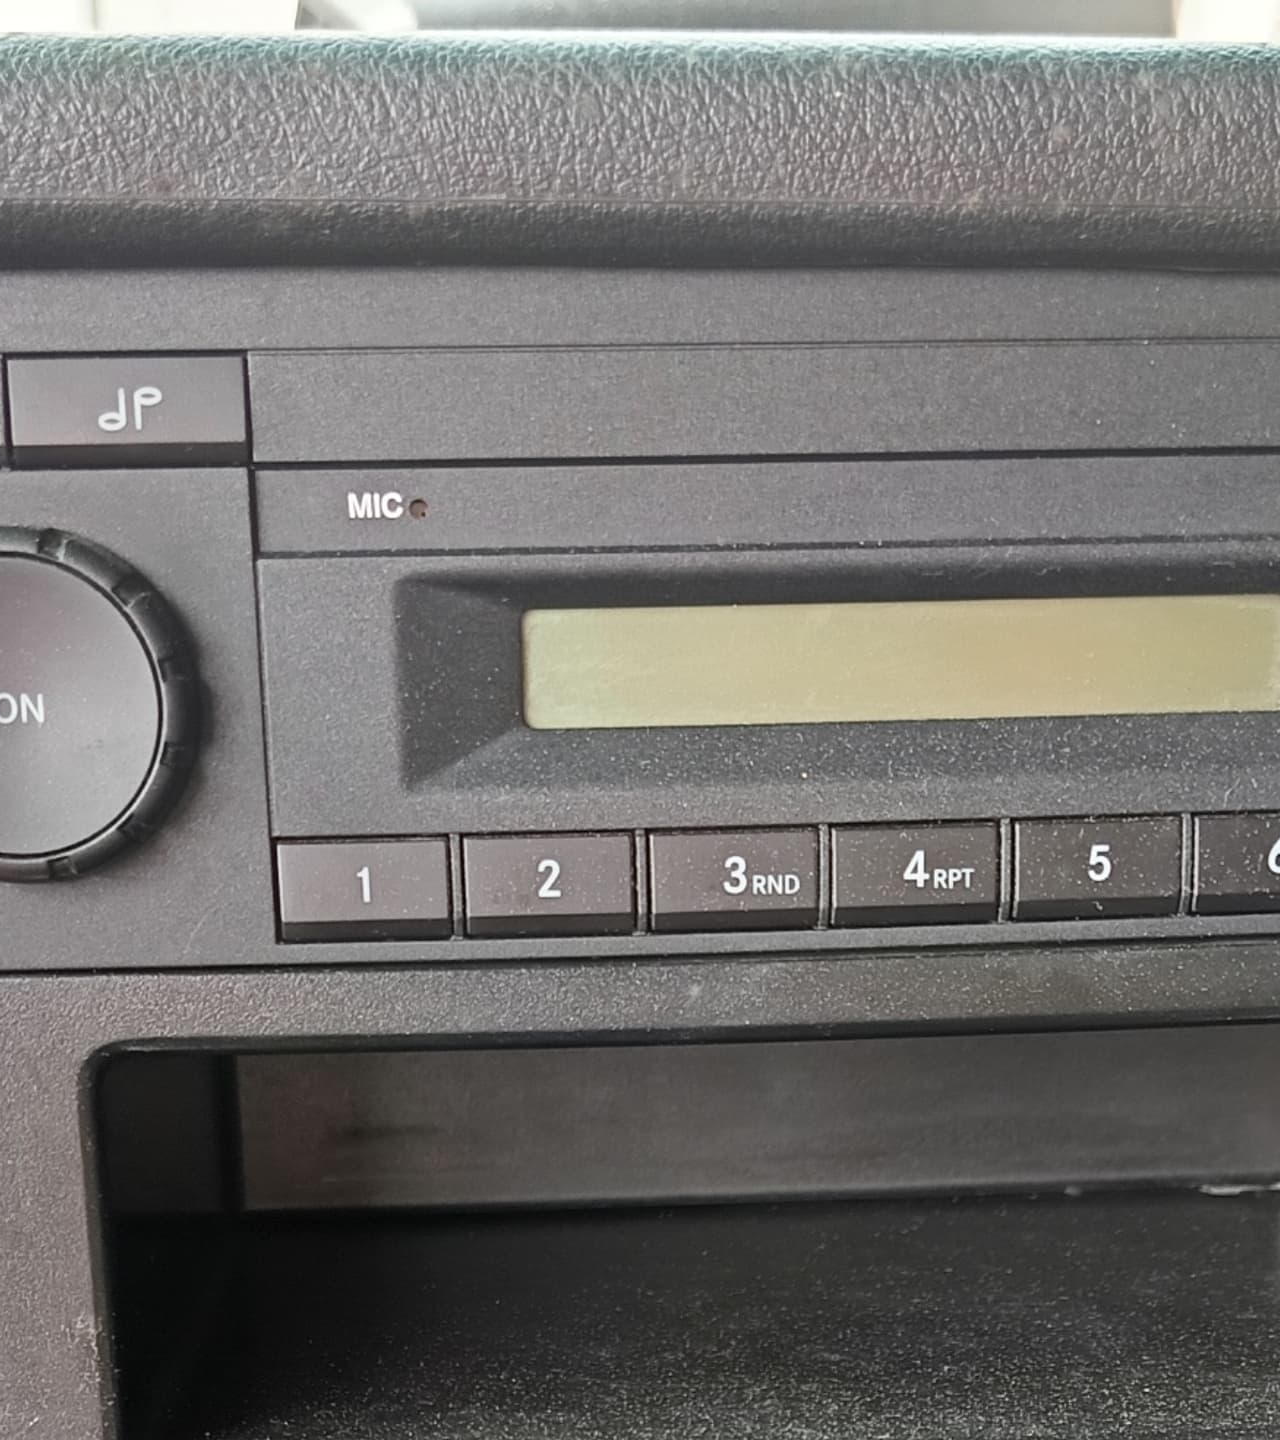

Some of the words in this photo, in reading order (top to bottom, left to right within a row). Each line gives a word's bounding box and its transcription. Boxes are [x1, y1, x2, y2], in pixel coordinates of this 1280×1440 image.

[347, 491, 404, 519] MIC
[538, 859, 562, 898] 2
[1088, 844, 1111, 882] 5
[356, 866, 371, 903] 1
